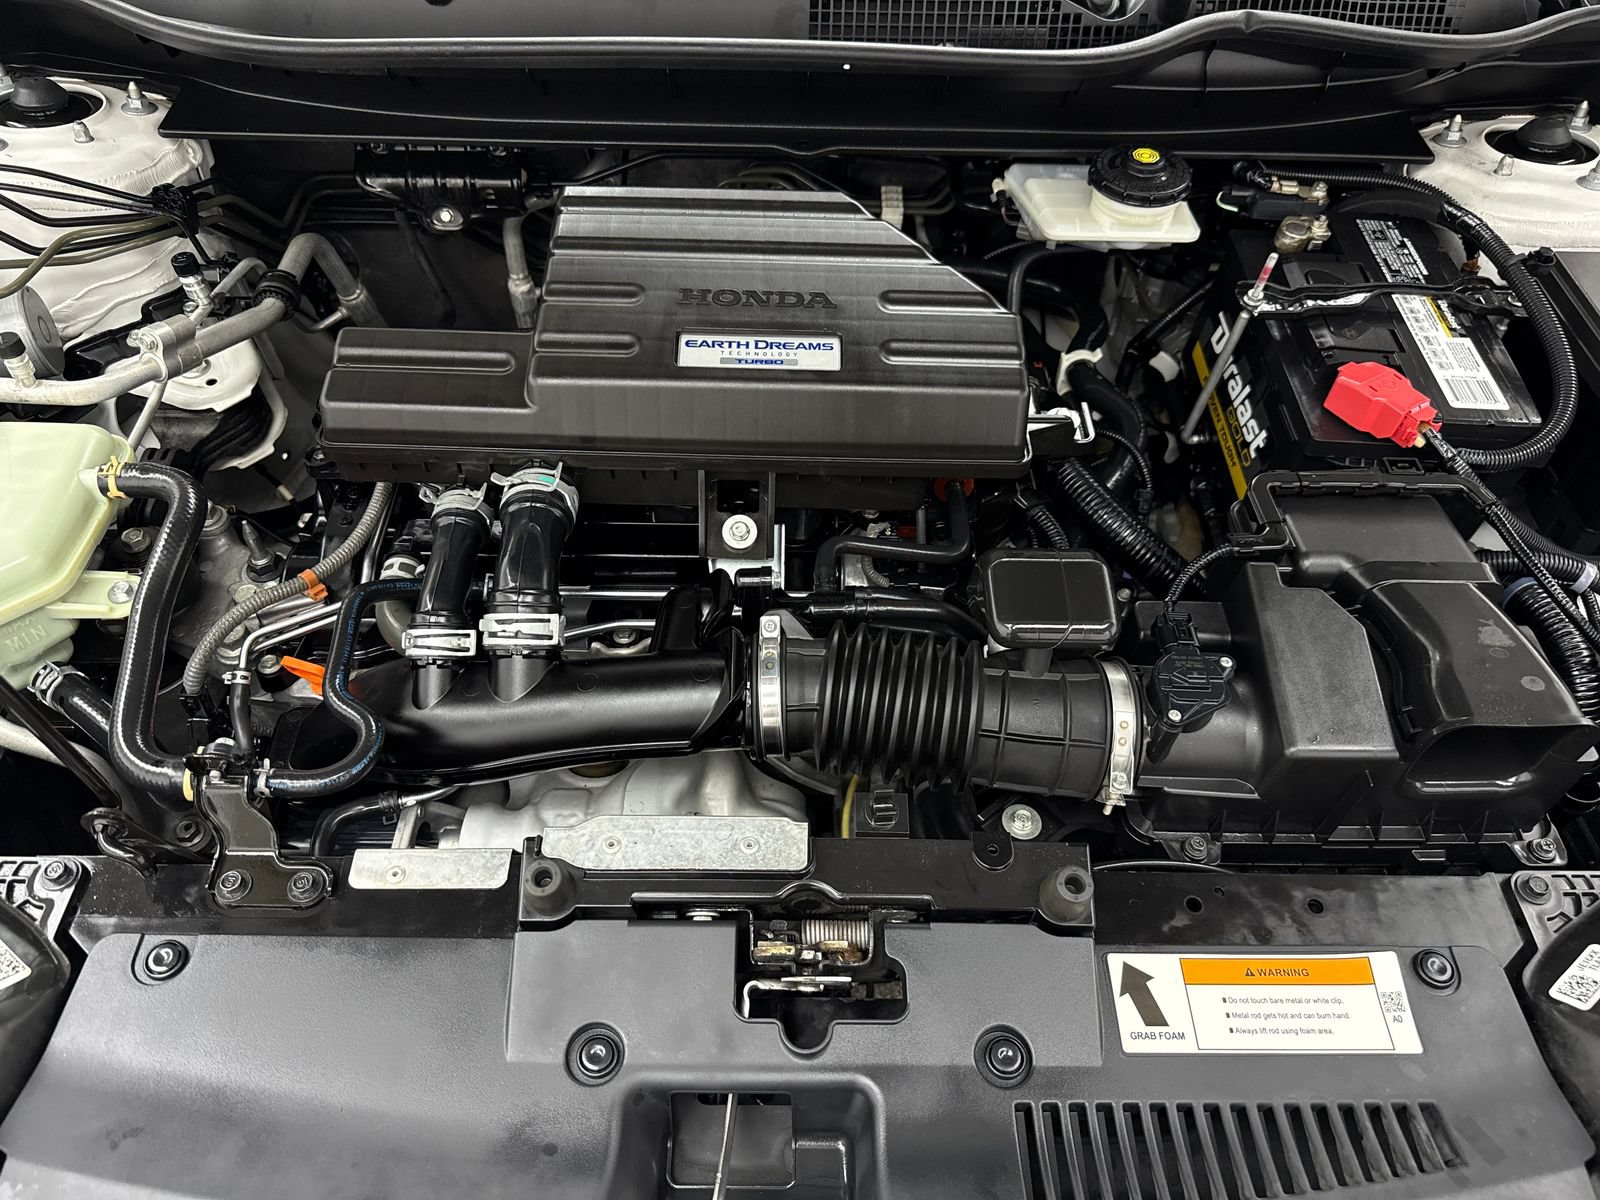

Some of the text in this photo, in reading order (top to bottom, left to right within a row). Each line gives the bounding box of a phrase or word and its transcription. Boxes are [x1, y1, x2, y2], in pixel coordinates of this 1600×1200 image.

[677, 288, 838, 309] HONDA
[684, 339, 834, 351] EARTH DREAMS
[1210, 310, 1268, 460] Dralast
[1227, 406, 1252, 468] GOLD
[1220, 426, 1237, 469] TOUGH
[5, 624, 48, 652] MIN
[1256, 968, 1310, 977] WARNING
[1330, 997, 1345, 1005] clip.
[1263, 1012, 1277, 1021] gets
[1130, 1031, 1186, 1040] GRAB FOAM
[1235, 1027, 1258, 1036] Always
[1281, 1027, 1299, 1036] using
